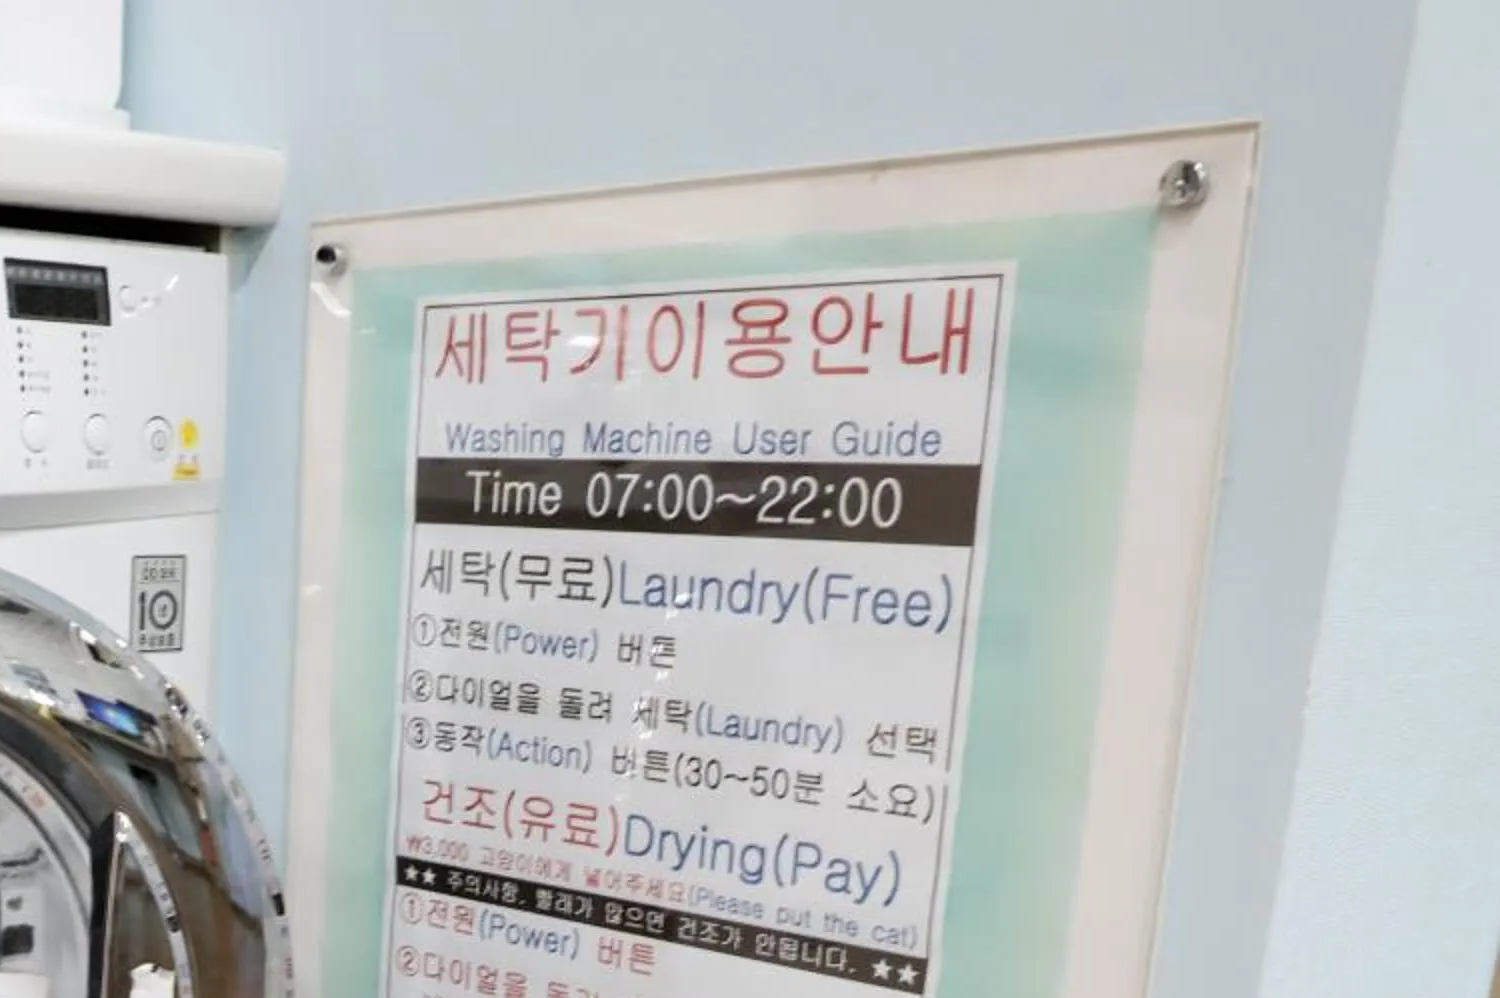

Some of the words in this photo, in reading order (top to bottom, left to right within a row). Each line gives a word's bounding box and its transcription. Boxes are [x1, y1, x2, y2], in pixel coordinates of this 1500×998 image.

[436, 289, 975, 384] 세탁기이용안내
[445, 423, 564, 458] Washing
[583, 422, 712, 456] Machine
[733, 422, 812, 456] User
[832, 421, 941, 457] Guide
[466, 470, 562, 514] Time
[587, 473, 902, 528] 07:00~22:00
[420, 548, 953, 635] 세탁(무료)Laundry(Free)
[617, 633, 677, 668] 버튼
[559, 683, 613, 724] 돌려
[632, 697, 844, 754] 세탁(Laundry)
[867, 722, 938, 763] 선택
[847, 776, 935, 824] 소요)
[423, 779, 902, 907] 건조(유료)Drying(Pay)
[535, 887, 595, 918] 빨래가
[604, 900, 665, 934] 많으면
[677, 915, 745, 950] 건조가
[776, 906, 814, 928] put
[824, 911, 861, 937] the
[871, 923, 919, 951] cat)
[598, 934, 656, 976] 버튼
